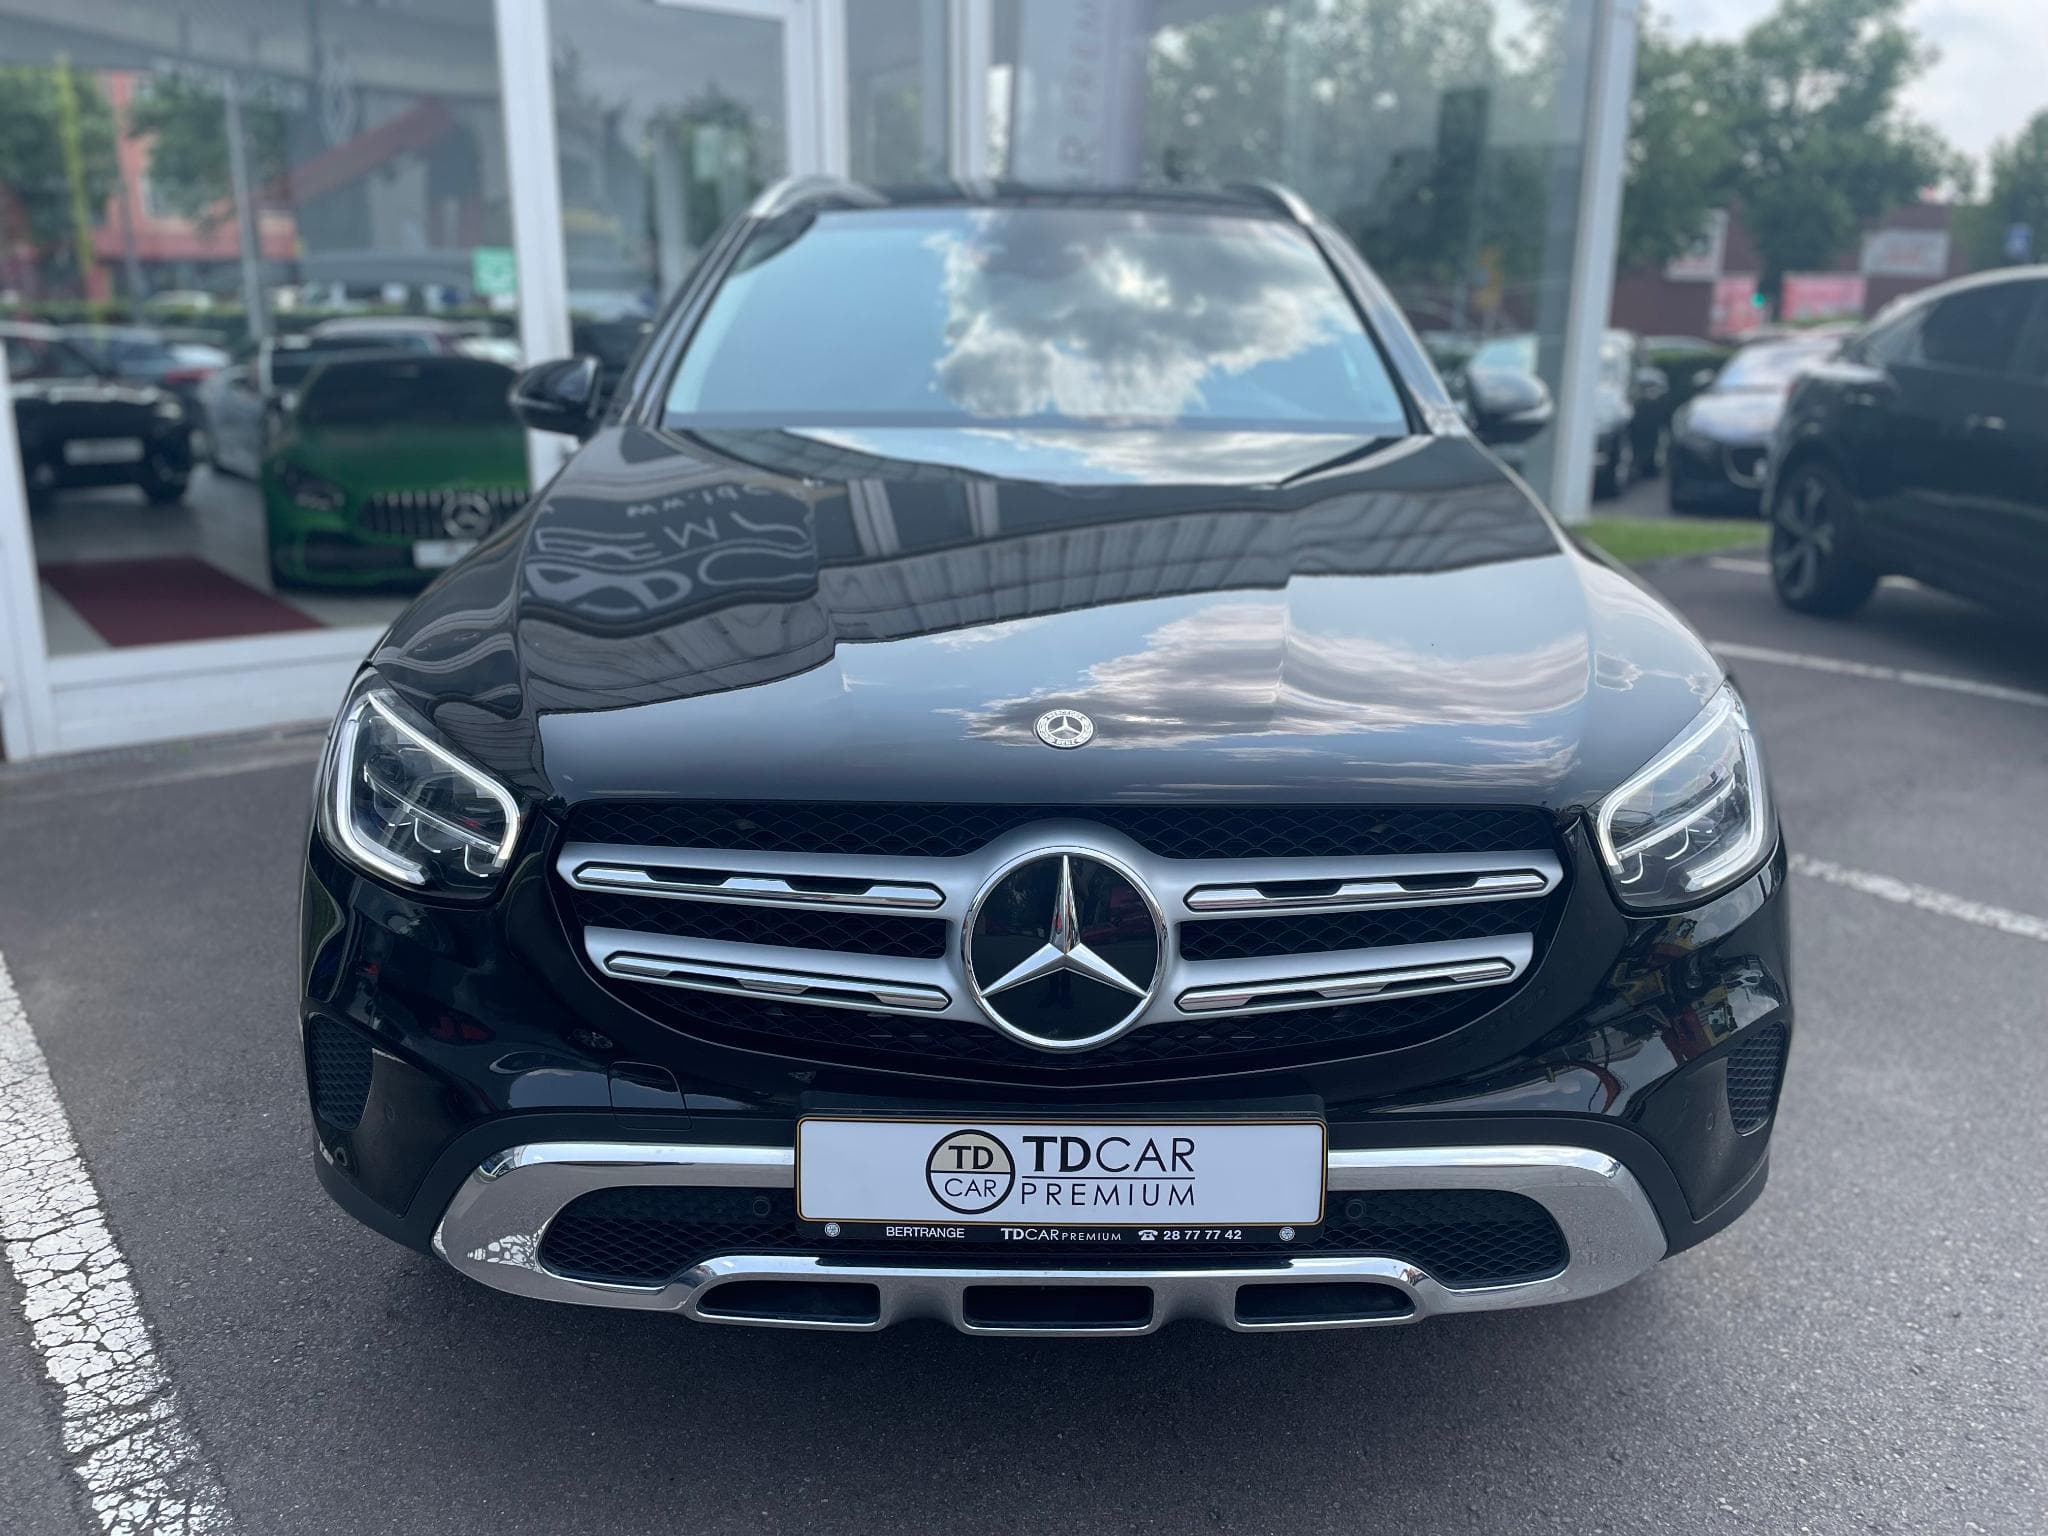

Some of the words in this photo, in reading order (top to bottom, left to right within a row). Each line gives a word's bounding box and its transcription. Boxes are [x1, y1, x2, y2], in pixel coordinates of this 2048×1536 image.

[947, 1145, 994, 1170] TD
[1022, 1135, 1196, 1173] TDCAR
[944, 1178, 997, 1198] CAR
[1021, 1182, 1195, 1207] PREMIUM
[886, 1226, 966, 1239] BERTRANGE
[1000, 1227, 1059, 1241] TDCAR
[1061, 1232, 1122, 1241] PREMIUM
[1163, 1230, 1181, 1241] 28
[1184, 1230, 1201, 1240] 77
[1204, 1229, 1221, 1240] 77
[1224, 1229, 1242, 1240] 42
